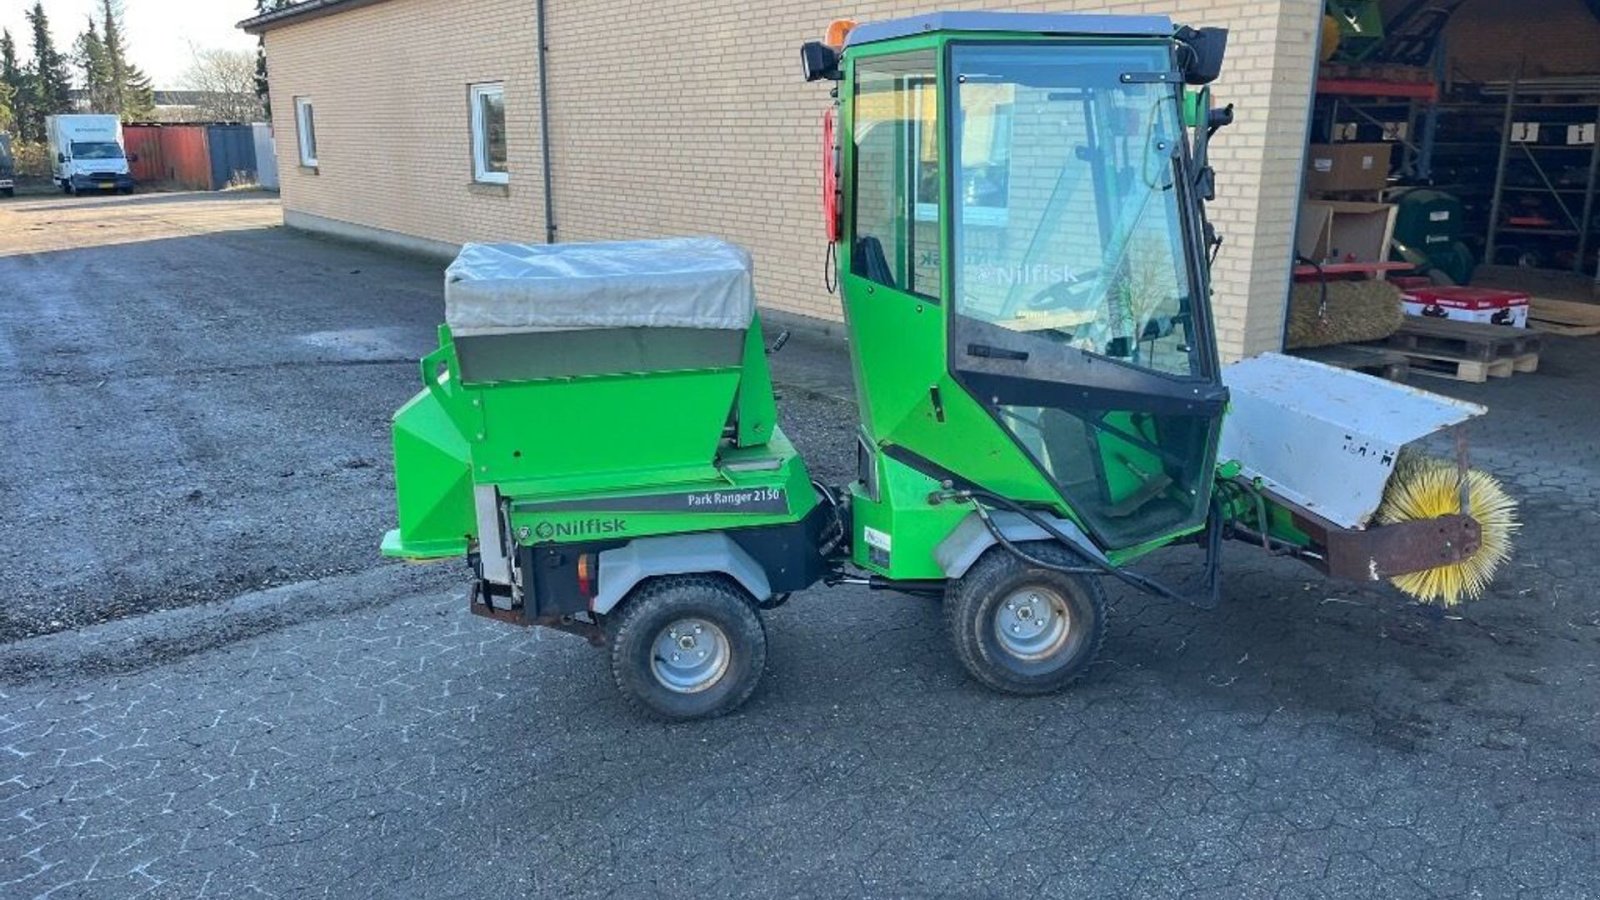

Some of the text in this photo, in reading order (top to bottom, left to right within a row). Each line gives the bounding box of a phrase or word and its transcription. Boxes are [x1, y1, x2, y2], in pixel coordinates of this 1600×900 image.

[997, 263, 1079, 285] Nilfisk
[688, 488, 780, 506] Park Ranger 2150
[556, 518, 627, 537] Nilfisk
